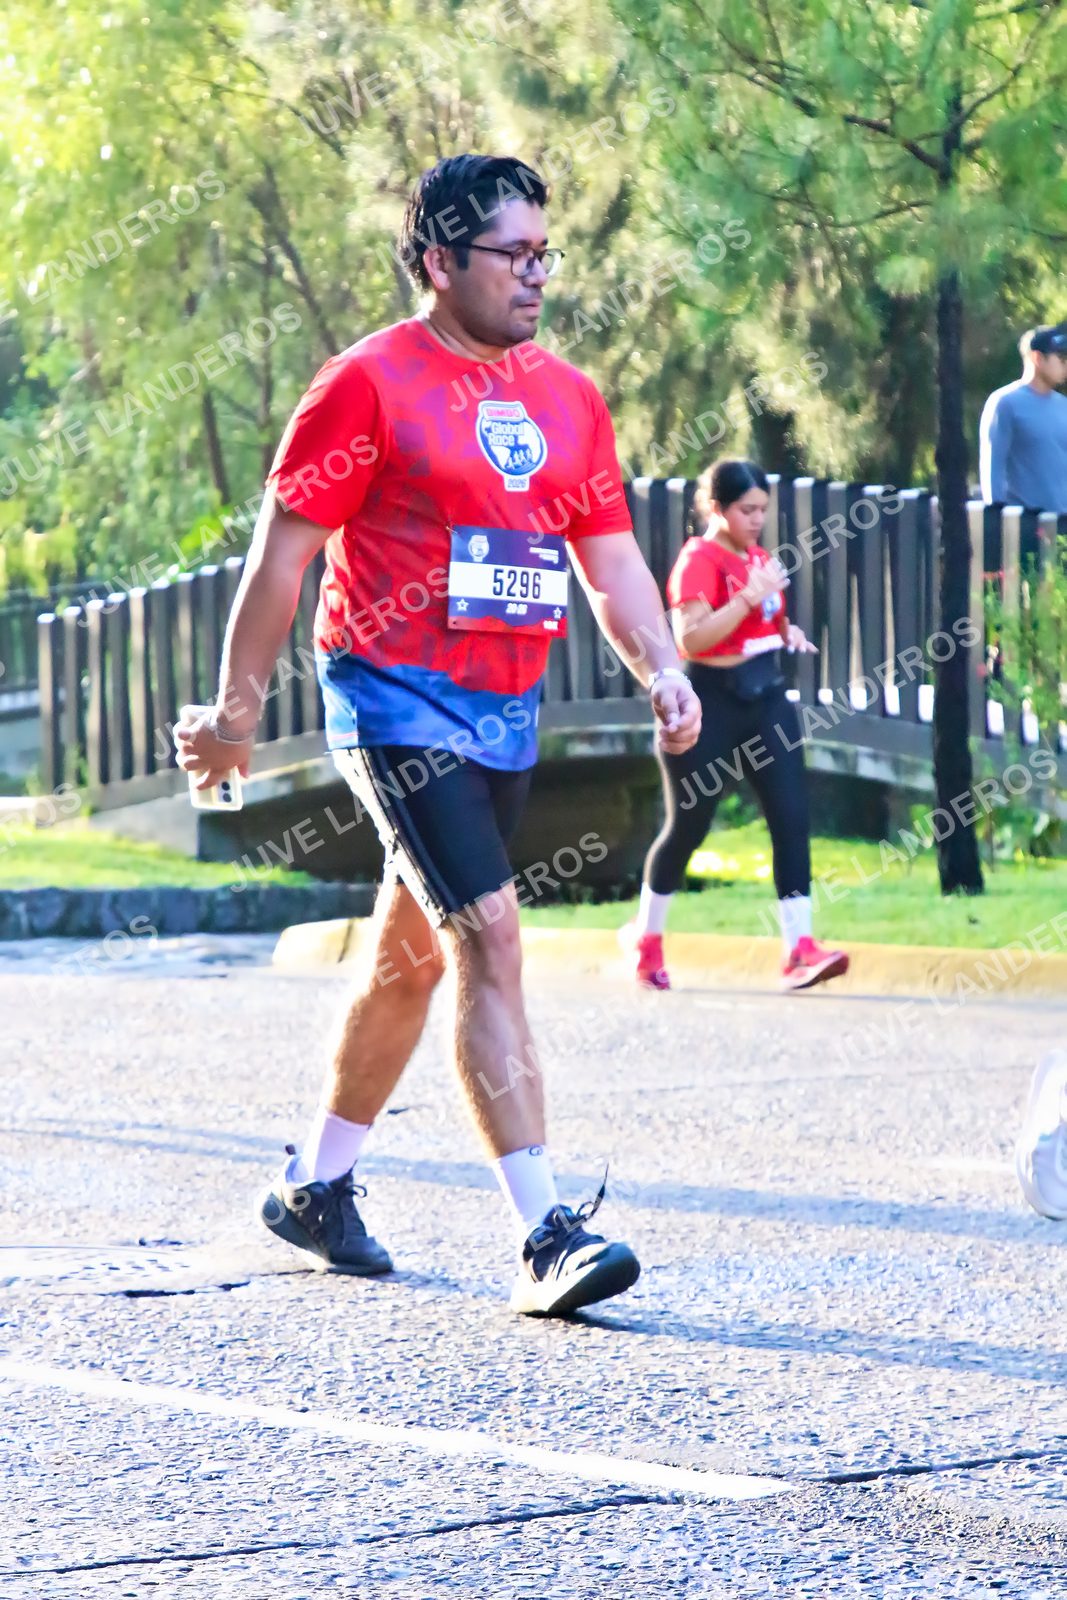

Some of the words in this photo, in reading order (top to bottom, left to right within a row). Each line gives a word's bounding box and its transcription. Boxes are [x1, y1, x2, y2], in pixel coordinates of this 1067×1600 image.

[491, 421, 524, 435] Global
[489, 433, 515, 446] Race
[493, 568, 541, 599] 5296
